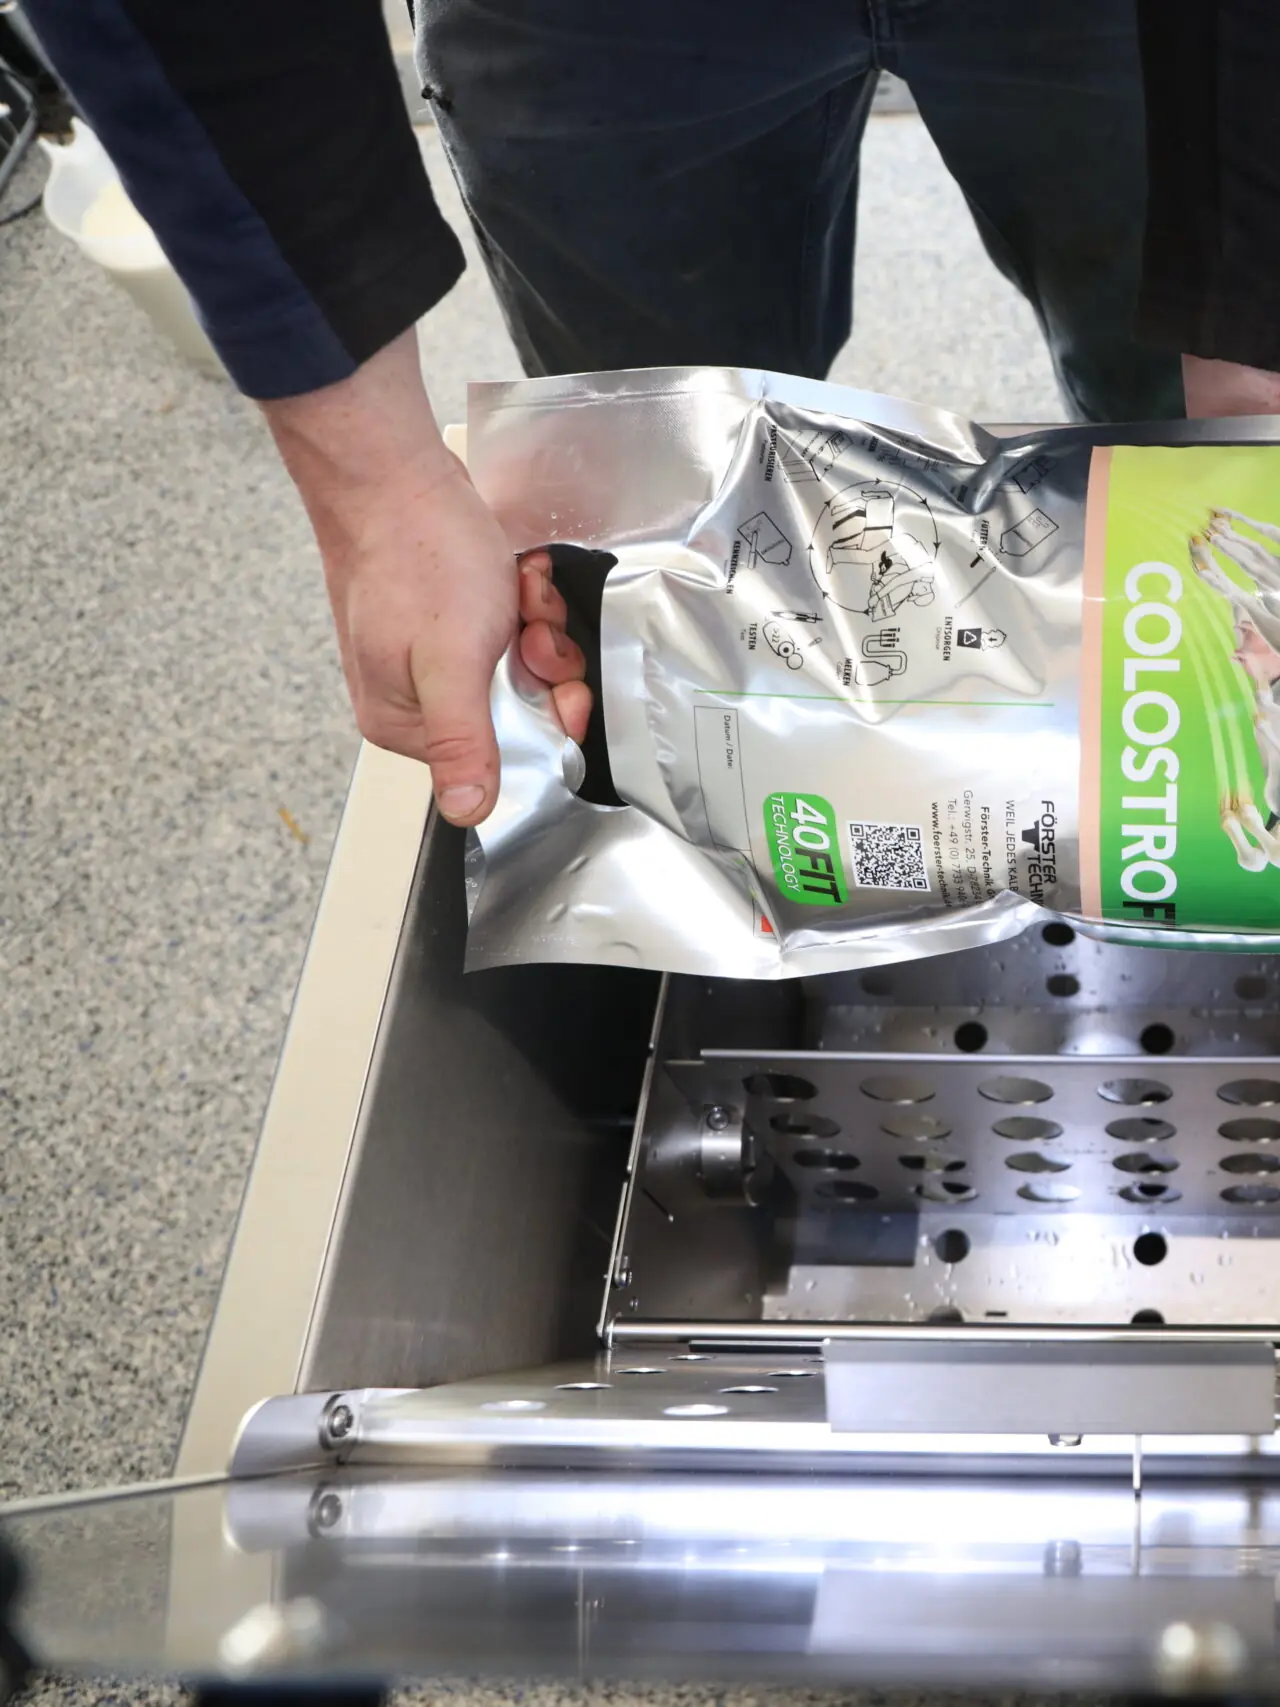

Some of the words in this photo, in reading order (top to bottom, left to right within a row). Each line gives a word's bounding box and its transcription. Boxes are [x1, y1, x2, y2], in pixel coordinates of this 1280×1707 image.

[748, 623, 758, 651] TESTEN
[943, 616, 953, 662] ENTSORGEN
[842, 657, 853, 687] MELKEN
[723, 715, 732, 741] Datum
[725, 748, 734, 769] Date:
[961, 790, 973, 844] Gerwigstr.
[1005, 800, 1015, 827] WEIL
[771, 796, 800, 893] TECHNOLOGY
[949, 824, 959, 844] +49
[980, 806, 995, 886] Förster-Technik
[1006, 830, 1017, 864] JEDES
[1041, 800, 1058, 884] FÖRSTER
[790, 798, 843, 903] 40FIT
[948, 847, 960, 860] (0)
[1008, 866, 1019, 892] KALB
